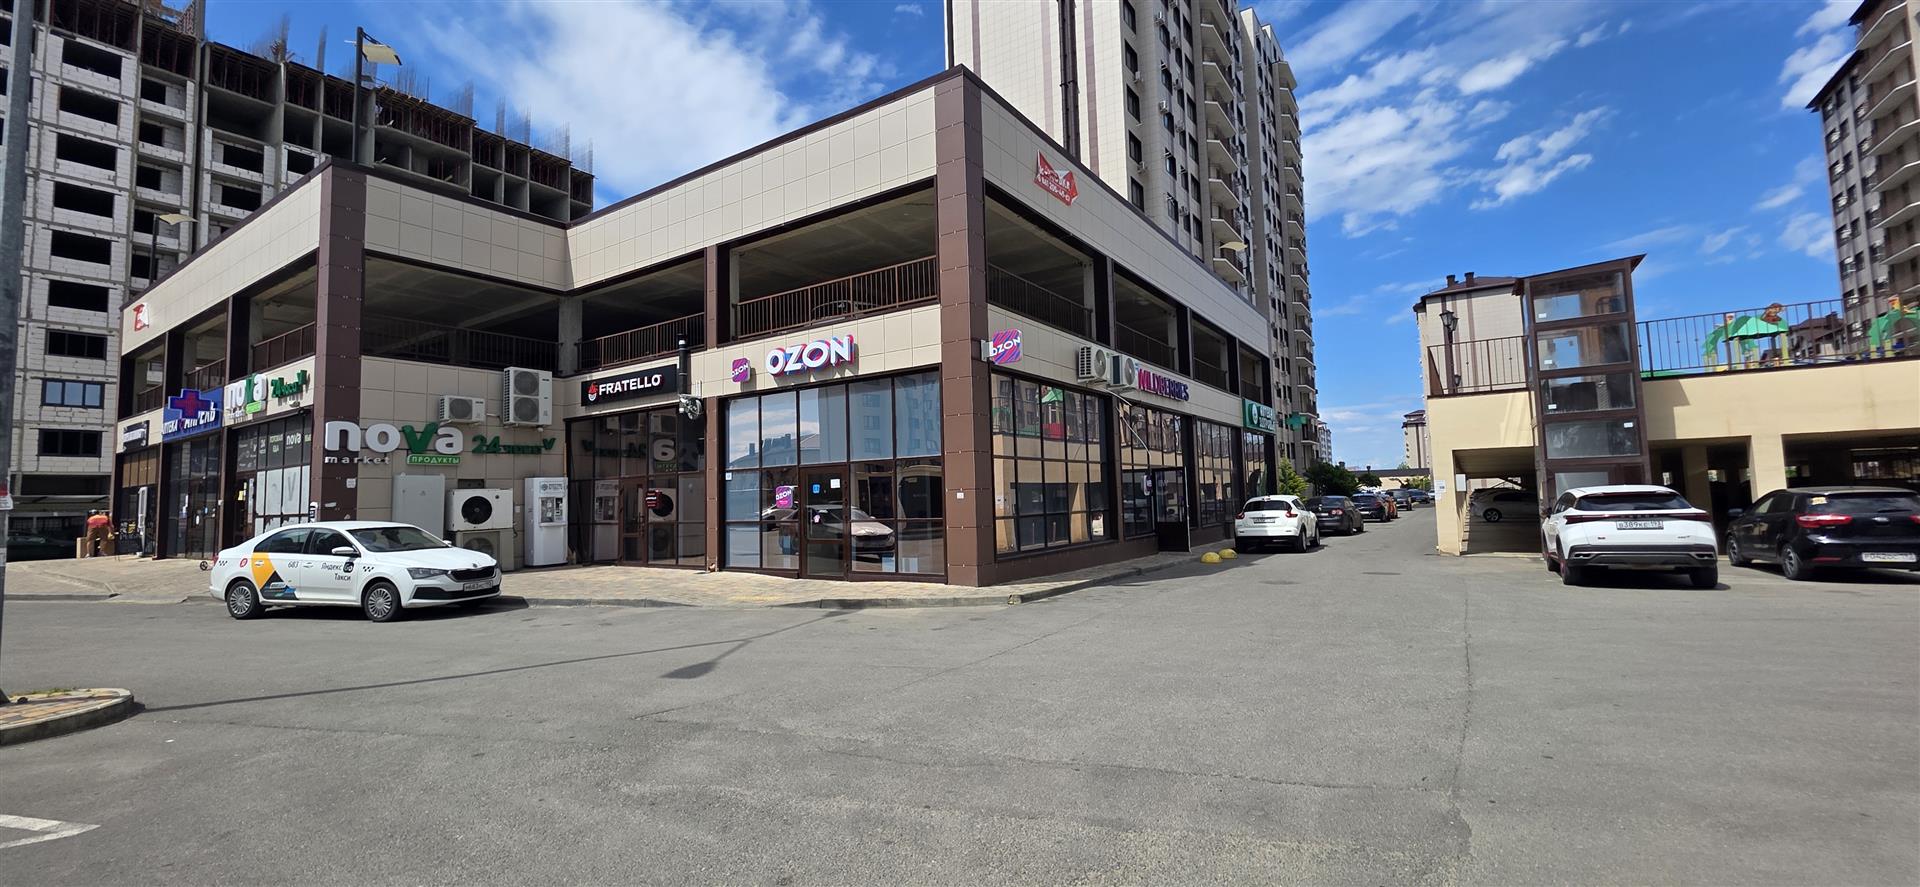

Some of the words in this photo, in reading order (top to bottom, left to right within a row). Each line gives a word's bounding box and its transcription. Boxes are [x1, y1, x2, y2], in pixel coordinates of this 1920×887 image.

[766, 336, 853, 375] OZON
[990, 336, 1020, 356] OZON
[732, 363, 749, 377] OZON
[227, 374, 266, 407] nova
[599, 374, 661, 395] FRATELLO
[1137, 368, 1189, 401] WILDBERRIES
[325, 421, 463, 454] nova
[472, 435, 500, 454] 24
[324, 456, 390, 464] market
[776, 490, 791, 500] OZON
[321, 562, 342, 570] Яндекс
[335, 573, 351, 581] Такси
